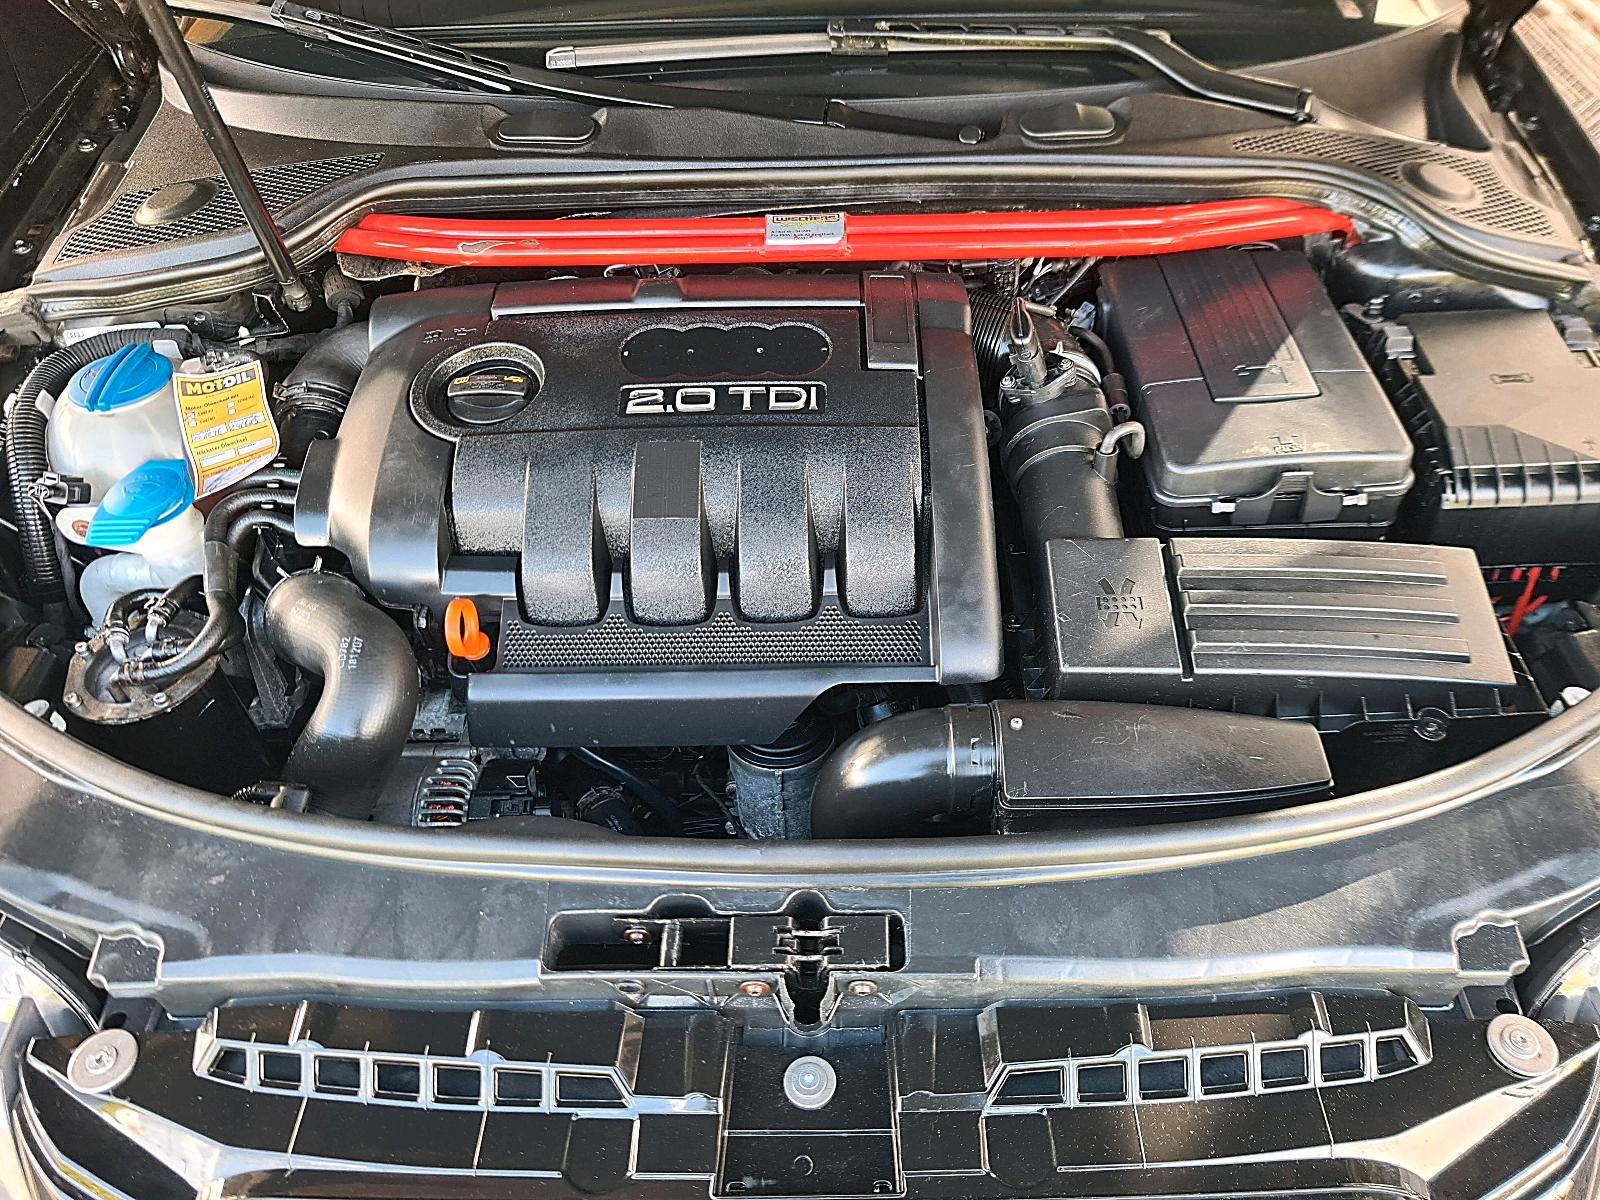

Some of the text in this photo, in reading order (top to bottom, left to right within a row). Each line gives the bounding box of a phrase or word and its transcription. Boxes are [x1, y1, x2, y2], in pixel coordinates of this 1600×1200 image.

[186, 370, 251, 396] MOTOIL
[625, 386, 819, 415] 2.0 TDI
